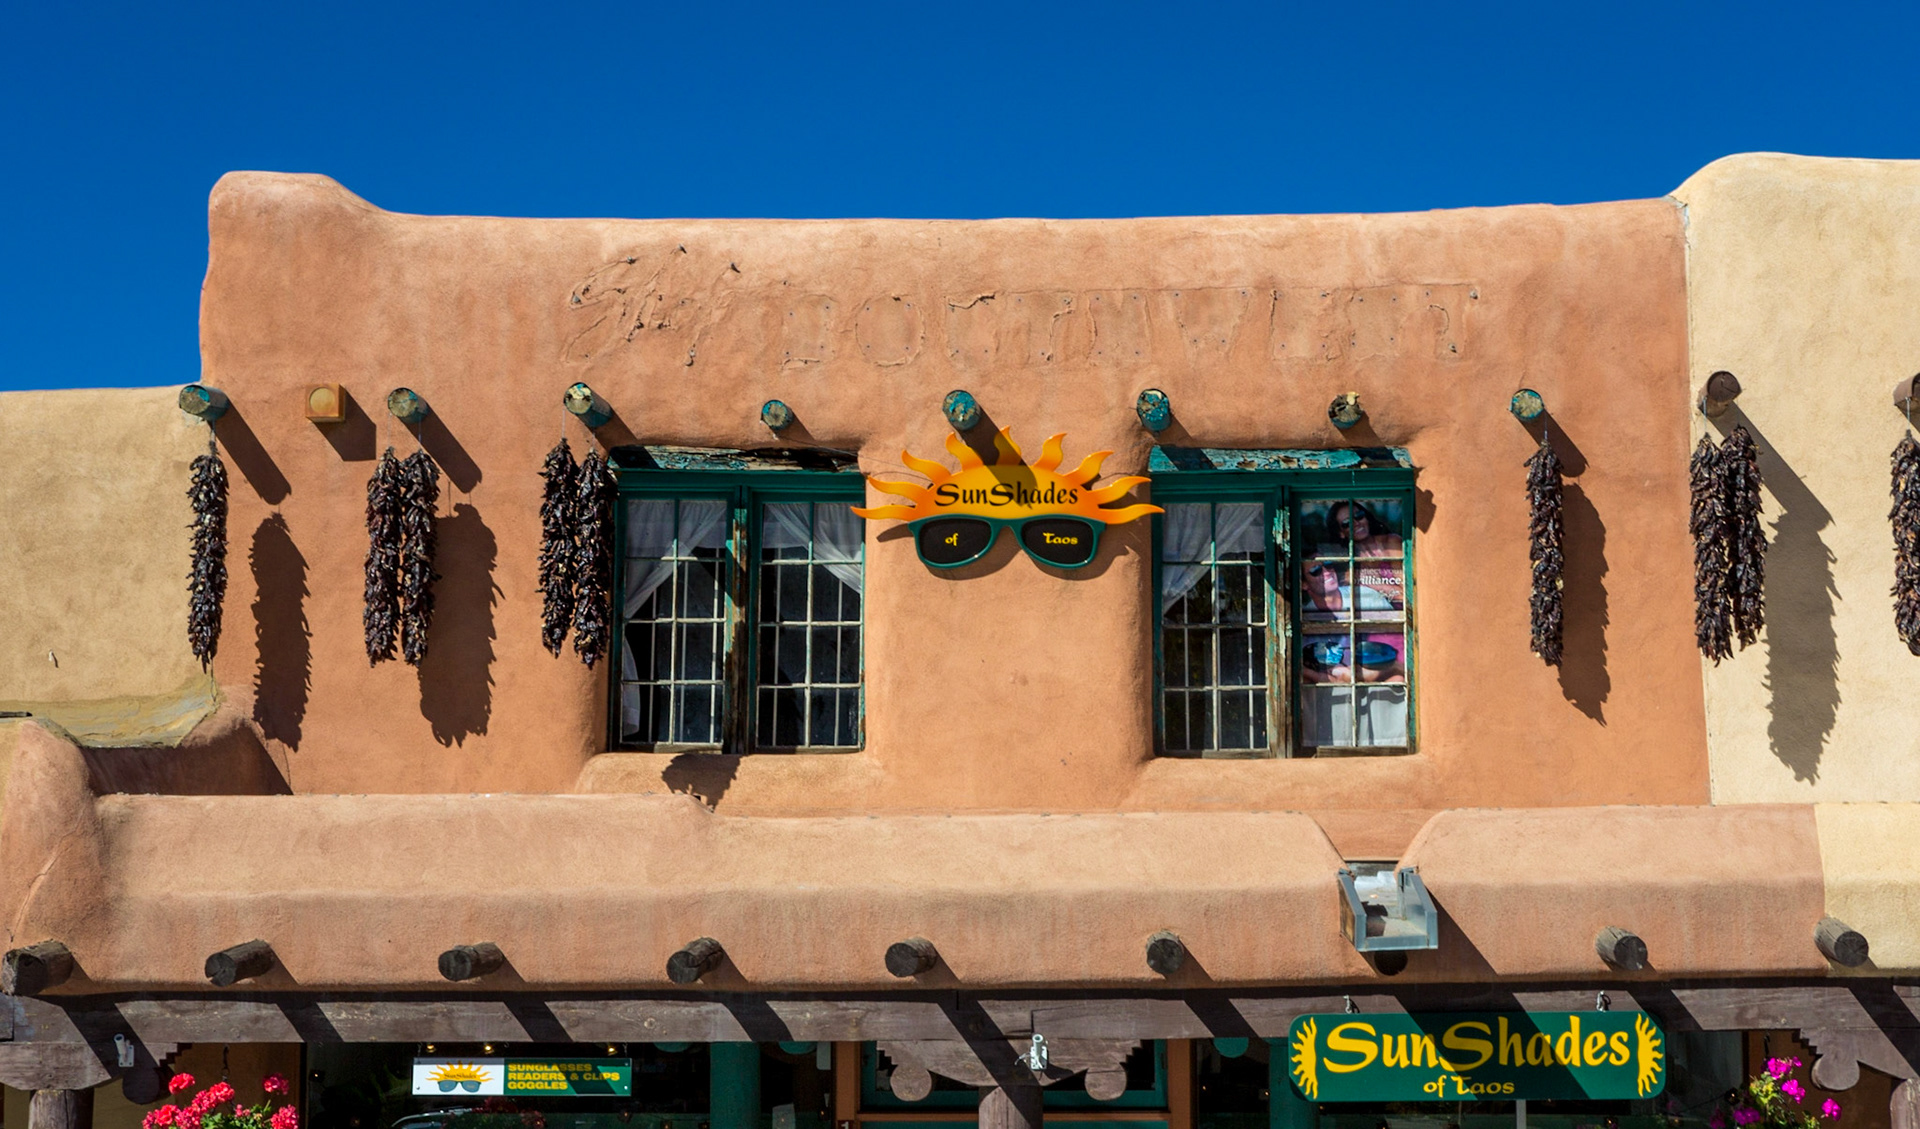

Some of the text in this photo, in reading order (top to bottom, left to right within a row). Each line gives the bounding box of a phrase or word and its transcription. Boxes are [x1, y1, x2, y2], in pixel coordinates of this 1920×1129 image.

[934, 481, 1078, 507] SunShades
[945, 532, 1078, 546] of Taos
[1323, 1015, 1630, 1073] SunShades
[508, 1063, 592, 1072] SUNGLASSES
[508, 1072, 620, 1081] READERS & CLIPS
[508, 1081, 568, 1090] GOGGLES
[1423, 1075, 1515, 1098] of Taos
